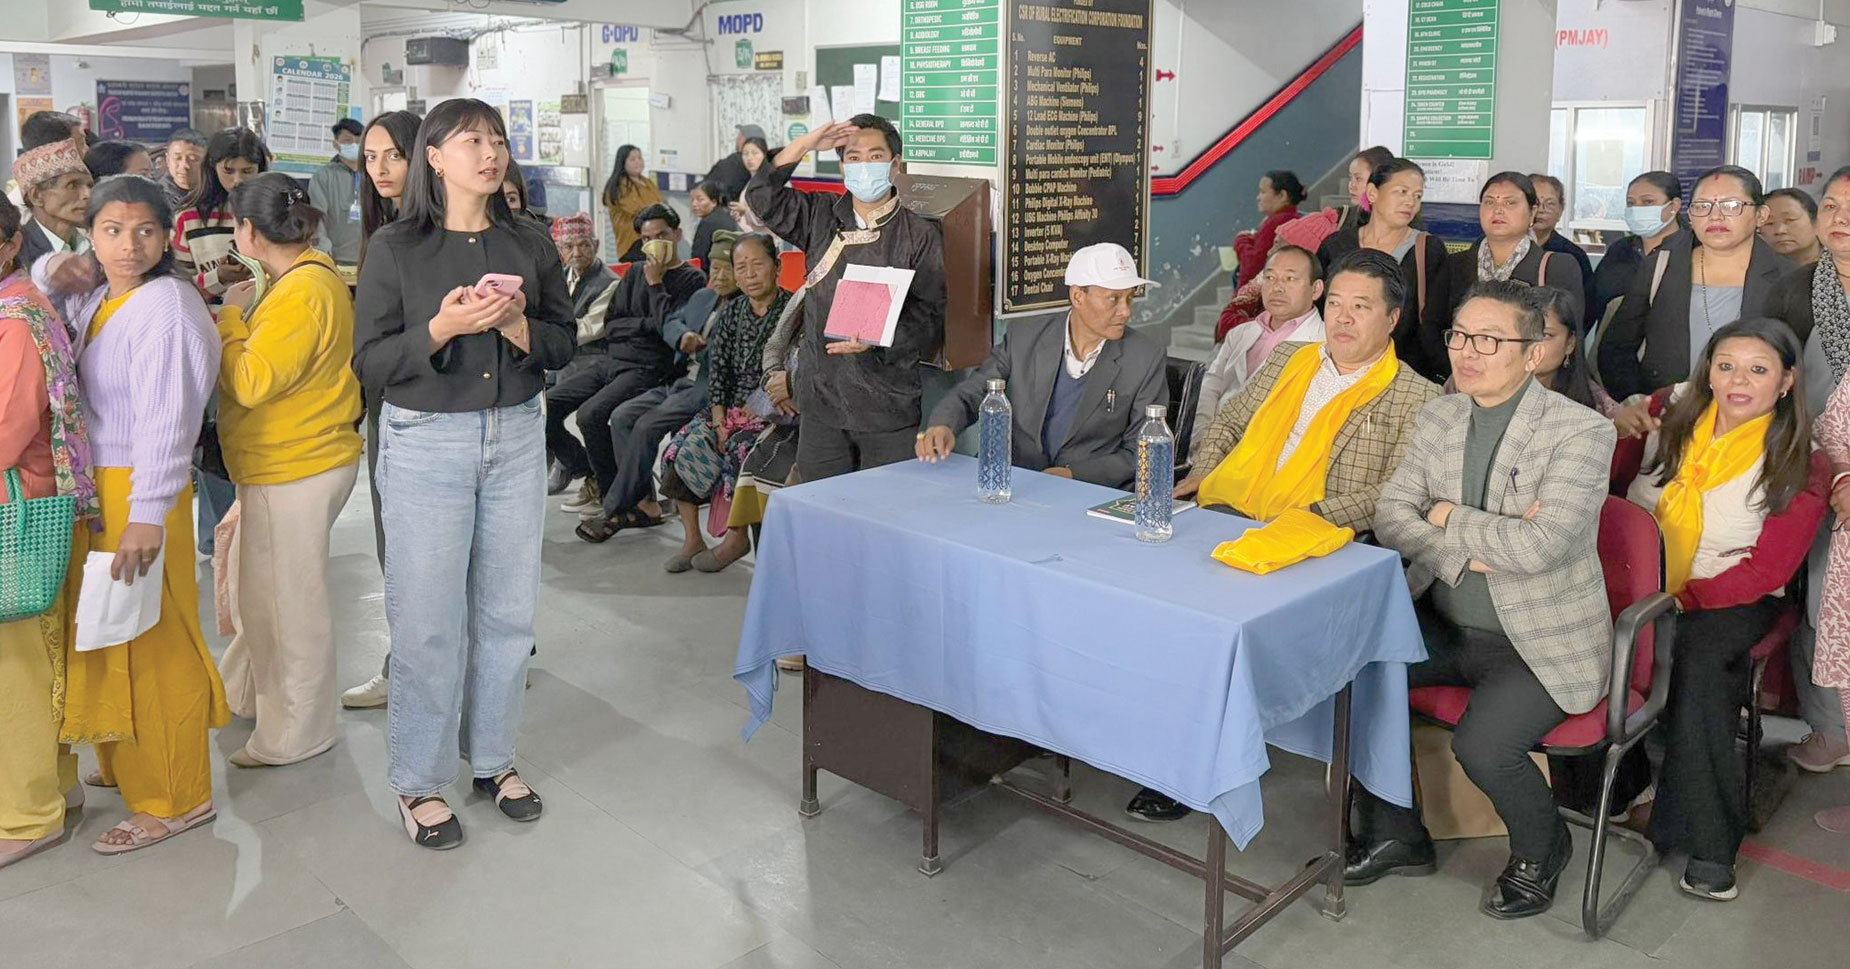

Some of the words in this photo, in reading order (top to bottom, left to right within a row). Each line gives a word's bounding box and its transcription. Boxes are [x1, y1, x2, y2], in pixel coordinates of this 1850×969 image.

[1019, 4, 1028, 20] CSR
[1029, 5, 1035, 20] OF
[1036, 6, 1050, 22] RURAL
[1051, 7, 1088, 25] ELECTRIFICATION
[1088, 9, 1117, 28] CORPORATION
[1118, 13, 1143, 29] FOUNDATION
[718, 13, 763, 35] MOPD
[1053, 35, 1083, 46] EQUIPMENT
[1554, 28, 1609, 50] (PMJAY)
[1014, 49, 1019, 61] 1
[1027, 50, 1048, 62] Reverse
[1048, 51, 1056, 63] AC
[282, 67, 322, 78] CALENDAR
[915, 75, 926, 84] MCH
[1014, 65, 1019, 76] 2
[1027, 65, 1041, 77] Multi
[1041, 66, 1052, 78] Para
[1053, 67, 1072, 78] Monitor
[1072, 67, 1092, 81] (Philips)
[1013, 80, 1018, 91] 3
[1027, 80, 1056, 93] Mechanical
[1056, 81, 1080, 94] Ventilator
[1080, 82, 1099, 96] (Philips)
[915, 105, 924, 113] ENT
[1013, 95, 1018, 106] 4
[1027, 96, 1038, 106] ABG
[1038, 96, 1060, 107] Machine
[1060, 96, 1084, 109] (Siemens)
[915, 120, 935, 128] GENERAL
[1013, 110, 1018, 121] 5
[1027, 110, 1034, 121] 12
[1034, 111, 1047, 121] Lead
[1047, 110, 1058, 121] ECG
[1058, 110, 1079, 121] Machine
[1079, 111, 1098, 124] (Philips)
[1137, 111, 1142, 122] 9
[1013, 125, 1018, 136] 6
[1026, 125, 1043, 136] Double
[1044, 126, 1059, 136] outlet
[1060, 127, 1077, 138] oxygen
[1077, 125, 1108, 136] Concentrator
[1108, 125, 1118, 136] BPL
[1137, 125, 1142, 135] 4
[1013, 140, 1017, 151] 7
[1026, 140, 1046, 151] Cardiac
[1046, 140, 1065, 151] Monitor
[1065, 140, 1084, 152] (Philips)
[1136, 139, 1141, 149] 2
[1012, 155, 1017, 165] 8
[1025, 154, 1047, 165] Portable
[1047, 154, 1064, 165] Mobile
[1064, 154, 1089, 166] endoscopy
[1089, 153, 1099, 163] unit
[1012, 169, 1017, 180] 9
[1025, 168, 1038, 179] Multi
[1038, 170, 1050, 181] para
[1051, 168, 1069, 178] cardiac
[1069, 167, 1088, 178] Monitor
[1088, 167, 1112, 180] (Pediatric)
[1012, 183, 1020, 195] 10
[1025, 183, 1042, 194] Bubble
[1043, 182, 1056, 193] CPAP
[1057, 182, 1077, 193] Machine
[1012, 198, 1019, 209] 11
[1025, 197, 1041, 209] Philips
[1042, 197, 1058, 209] Digital
[1059, 196, 1073, 208] X-Ray
[1073, 195, 1093, 206] Machine
[1012, 213, 1019, 224] 12
[1025, 212, 1036, 223] USG
[1036, 211, 1057, 222] Machine
[1057, 210, 1073, 223] Philips
[1074, 209, 1091, 222] Affinity
[1092, 208, 1098, 219] 30
[1012, 228, 1019, 239] 13
[1024, 226, 1044, 238] Inverter
[1134, 219, 1139, 230] 2
[1012, 242, 1019, 252] 14
[1024, 241, 1044, 254] Desktop
[1045, 239, 1069, 252] Computer
[1134, 232, 1139, 243] 7
[1011, 256, 1019, 267] 15
[1023, 255, 1045, 267] Portable
[1045, 254, 1060, 266] X-Ray
[1134, 245, 1139, 256] 2
[1011, 271, 1019, 282] 16
[1023, 270, 1042, 283] Oxygen
[1011, 285, 1019, 297] 17
[1023, 284, 1040, 295] Dental
[1040, 282, 1054, 293] Chair
